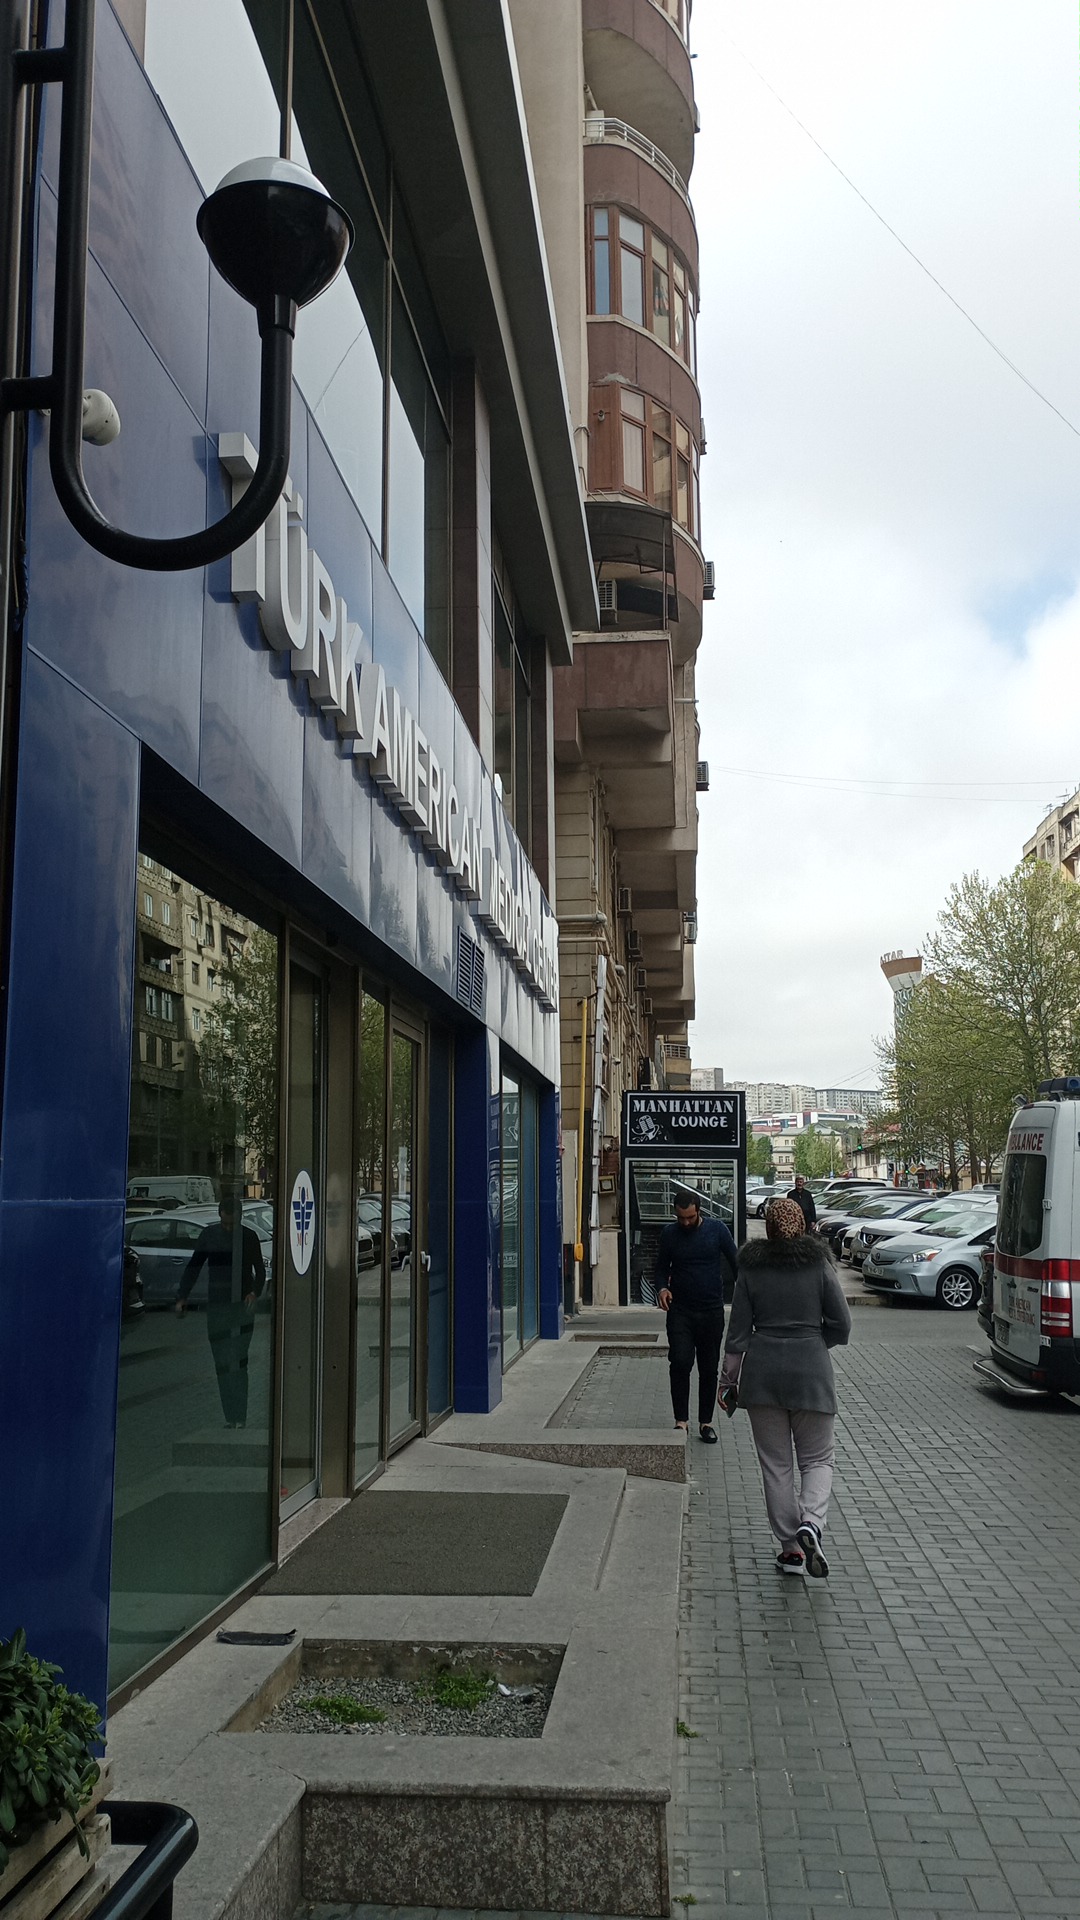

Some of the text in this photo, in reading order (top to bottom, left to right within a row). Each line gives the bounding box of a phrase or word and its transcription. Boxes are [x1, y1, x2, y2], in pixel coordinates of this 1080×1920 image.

[354, 664, 483, 901] AMERICAN
[478, 847, 532, 976] MEDICAL
[633, 1099, 734, 1113] MANHATTAN
[671, 1115, 728, 1128] LOUNGE
